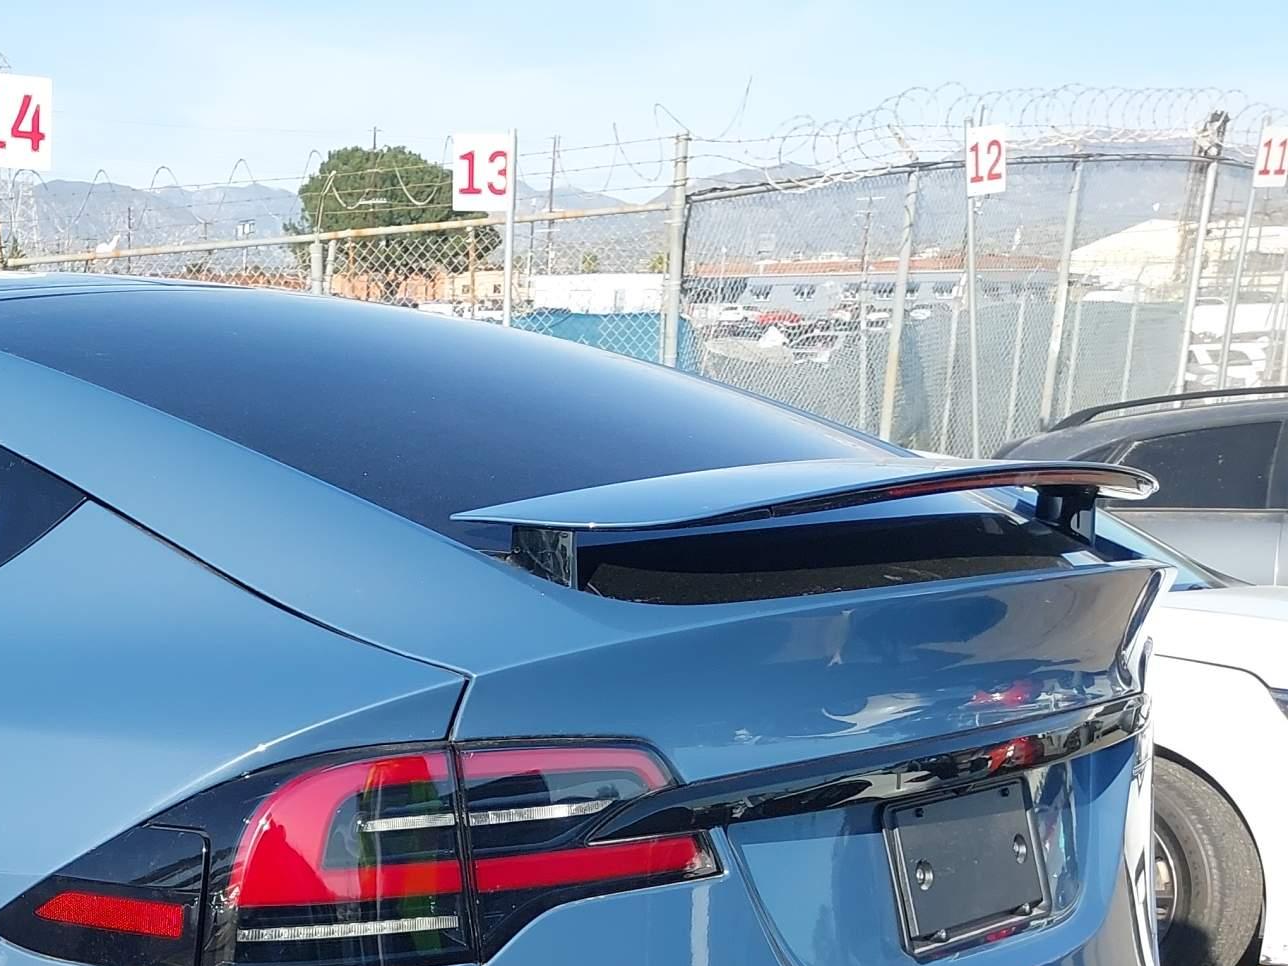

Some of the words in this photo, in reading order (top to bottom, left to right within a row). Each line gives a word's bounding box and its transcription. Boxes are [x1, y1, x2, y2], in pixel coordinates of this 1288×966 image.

[458, 149, 508, 196] 13
[971, 139, 1002, 184] 12
[1258, 138, 1288, 176] 11
